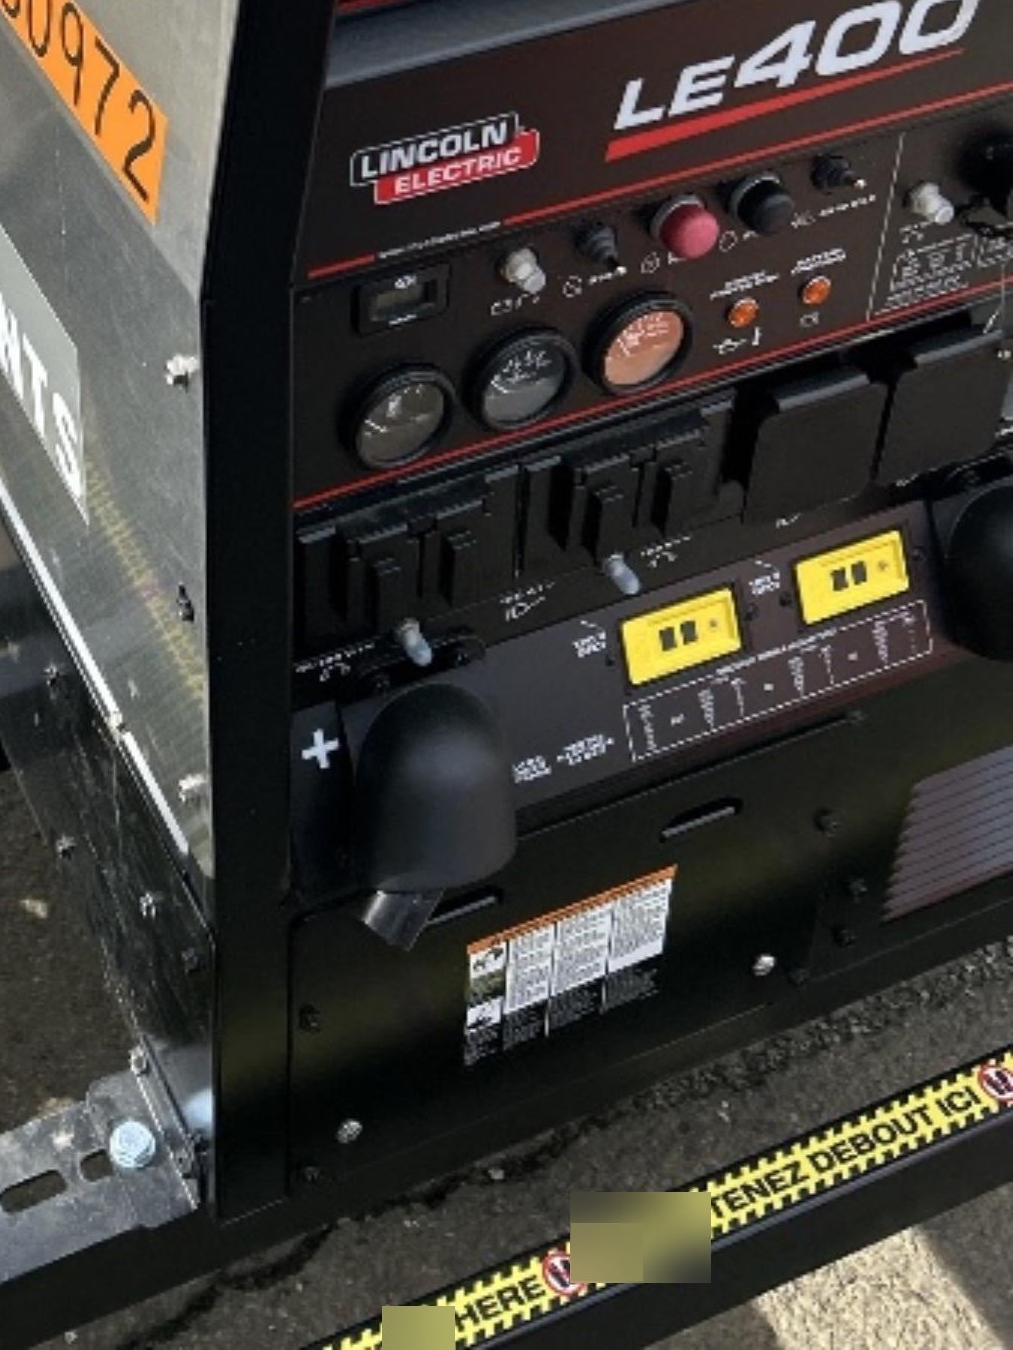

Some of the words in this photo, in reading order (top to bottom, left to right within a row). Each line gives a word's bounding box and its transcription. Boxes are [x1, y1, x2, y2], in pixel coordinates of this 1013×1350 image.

[361, 121, 507, 179] LINCOLN
[395, 146, 523, 195] ELECTRIC
[806, 1105, 935, 1174] DEBOUT
[934, 1086, 982, 1117] ICI
